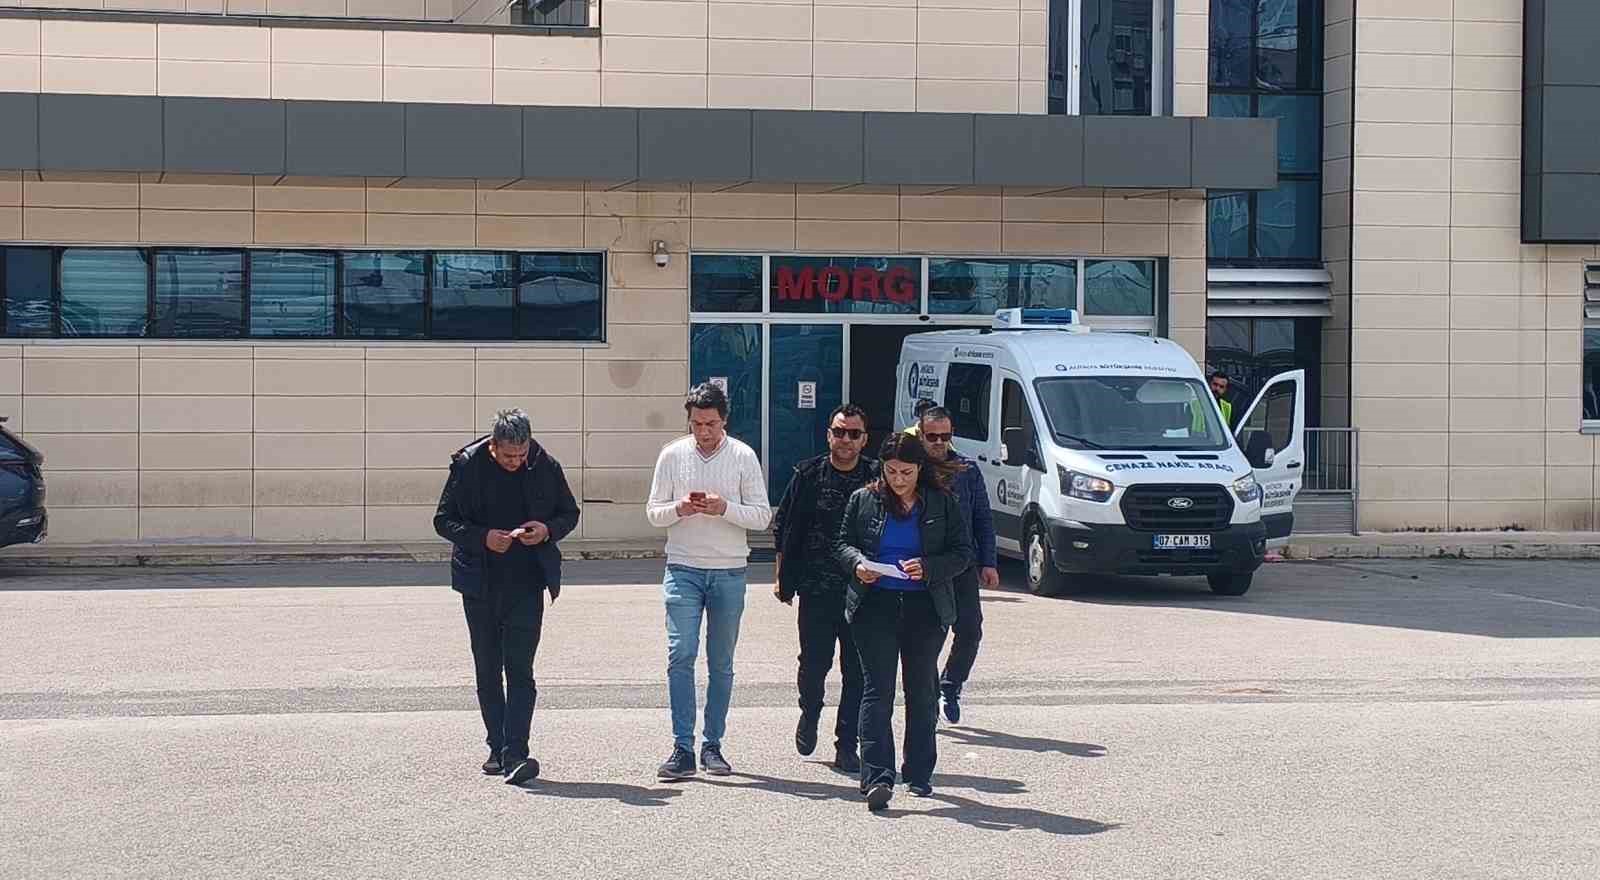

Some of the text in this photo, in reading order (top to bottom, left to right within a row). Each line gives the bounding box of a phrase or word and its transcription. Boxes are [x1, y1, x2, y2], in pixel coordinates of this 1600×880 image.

[777, 266, 914, 303] MORG
[1105, 461, 1155, 473] CENAZE
[1159, 535, 1209, 546] 07 CAM 315
